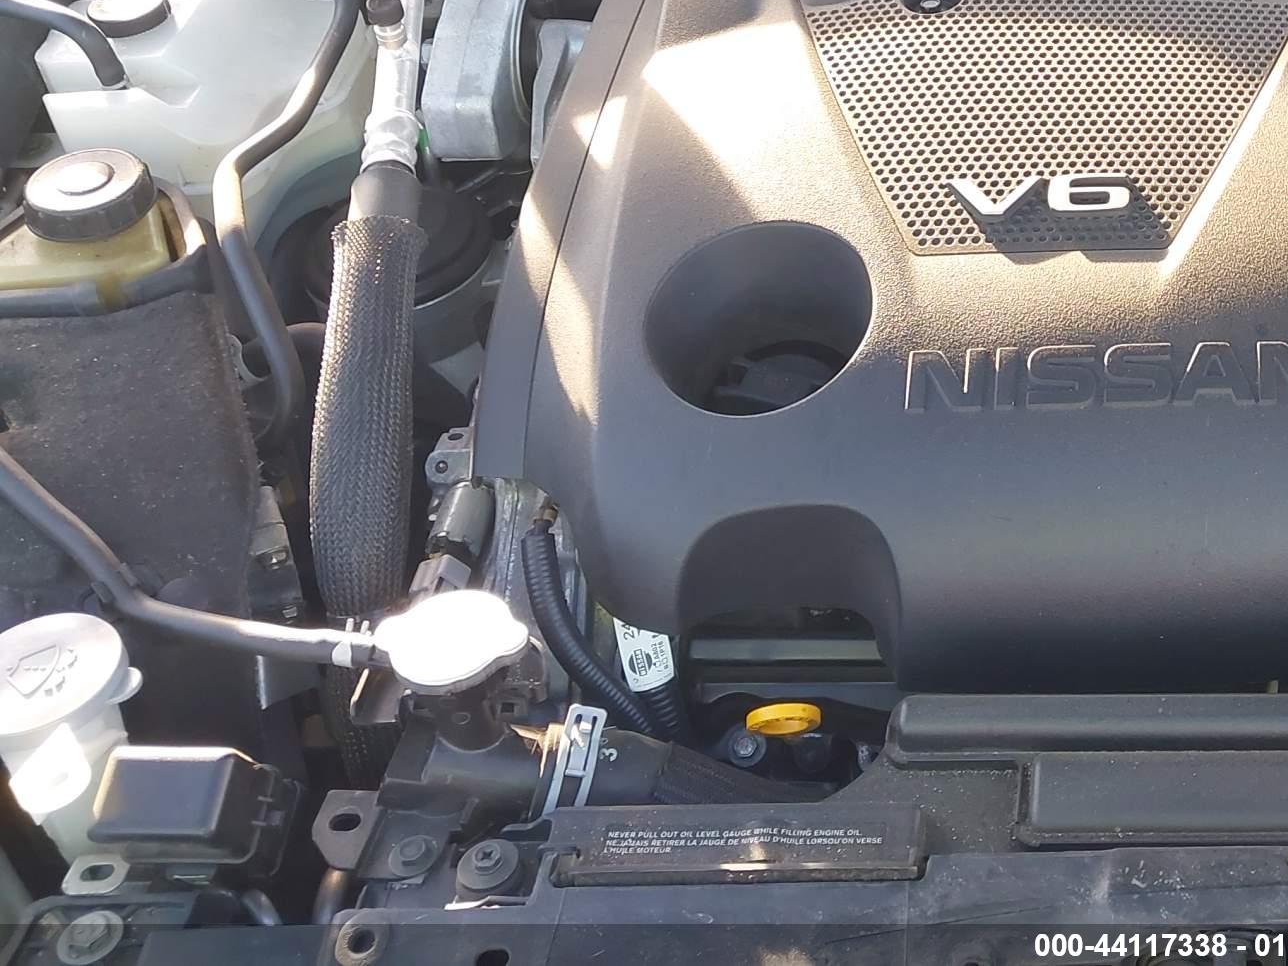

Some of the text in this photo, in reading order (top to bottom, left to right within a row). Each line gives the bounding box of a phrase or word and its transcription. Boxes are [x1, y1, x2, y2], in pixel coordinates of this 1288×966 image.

[946, 172, 1136, 218] V6
[680, 830, 693, 838] OIL
[696, 830, 720, 838] LEVEL
[722, 829, 752, 838] GAUGE
[780, 828, 812, 836] FILLING
[687, 838, 698, 846] LA
[699, 838, 726, 846] JAUGE
[741, 836, 770, 844] NIVEAU
